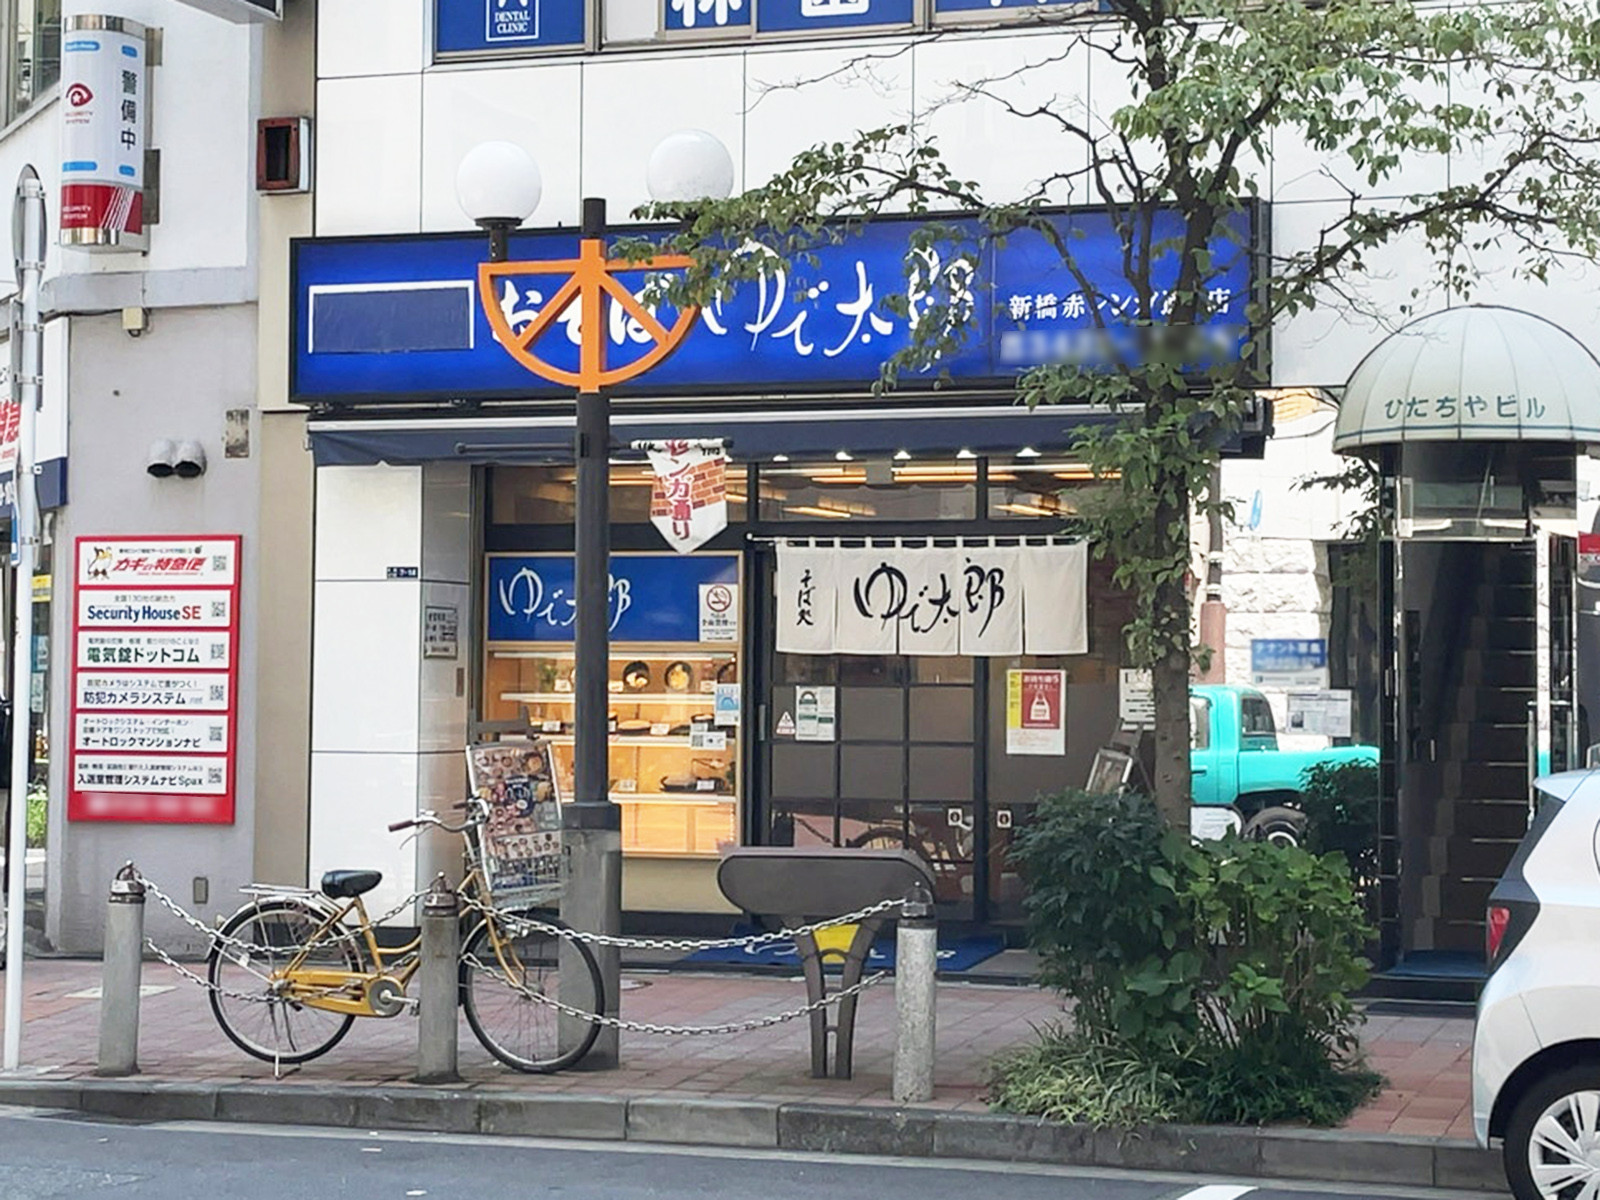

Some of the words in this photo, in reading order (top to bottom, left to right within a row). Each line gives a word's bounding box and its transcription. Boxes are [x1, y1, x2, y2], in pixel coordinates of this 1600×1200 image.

[494, 10, 531, 22] DENTAL
[496, 22, 528, 34] CLINIC
[121, 70, 138, 150] 警備中
[1385, 394, 1546, 420] ひたちやビル
[112, 557, 208, 571] カギの特急便
[853, 557, 1005, 638] ゆで太郎
[87, 604, 139, 623] Security
[142, 605, 180, 620] House
[182, 605, 202, 620] SE
[87, 647, 200, 663] 電気錠ドットコム
[83, 691, 186, 705] 防犯カメラシステム
[82, 736, 202, 748] オートロックマンションナビ
